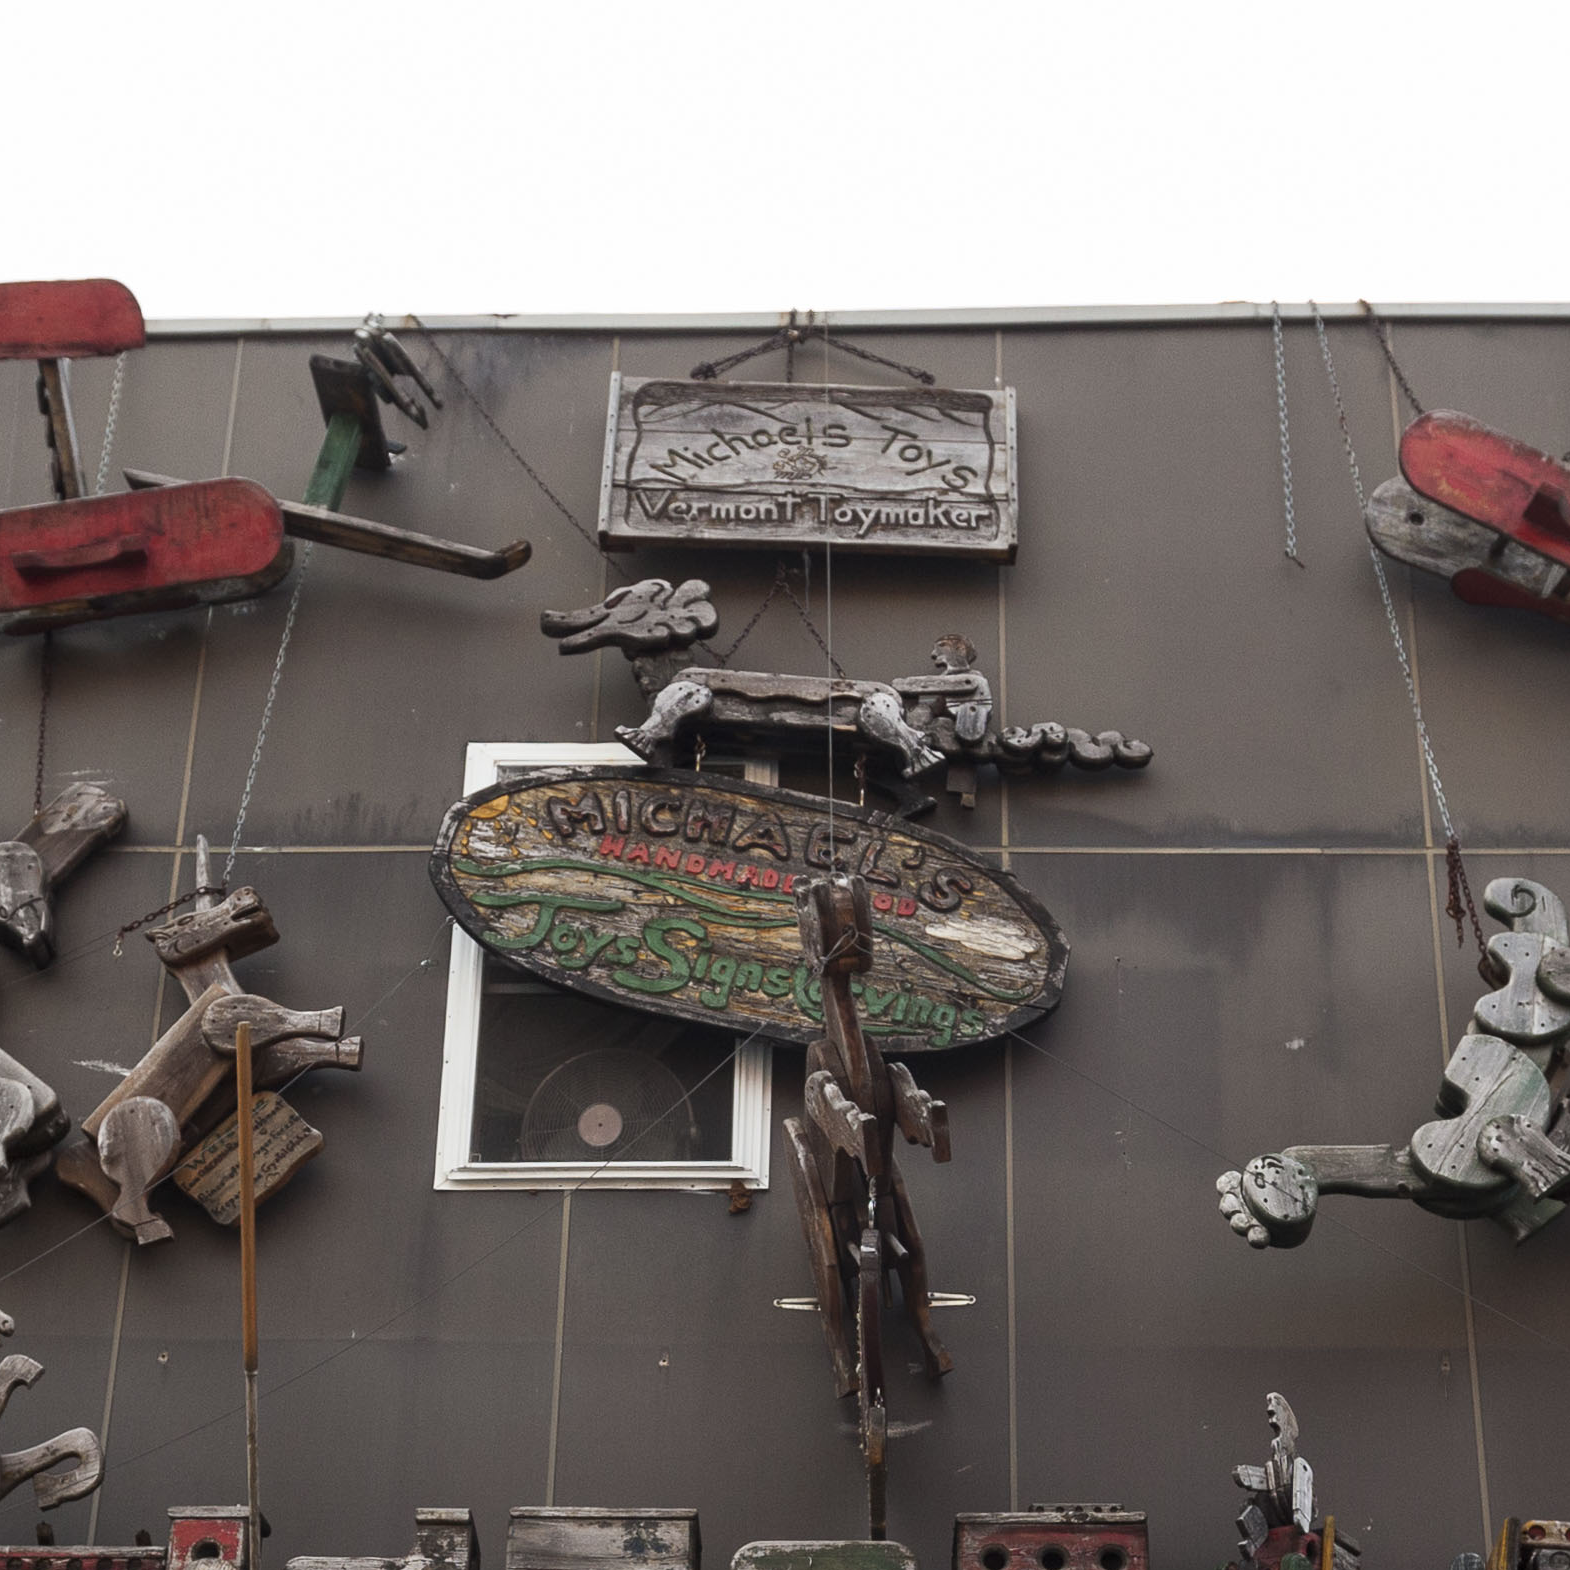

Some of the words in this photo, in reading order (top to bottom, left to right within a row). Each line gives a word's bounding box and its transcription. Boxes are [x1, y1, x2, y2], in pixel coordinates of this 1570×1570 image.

[649, 415, 853, 484] Michaels
[878, 423, 979, 491] Toys
[635, 488, 804, 523] Vermont
[805, 491, 993, 538] Toymaker
[545, 789, 975, 914] MICHAEL'S
[471, 893, 641, 969] Toys
[613, 917, 793, 1010] Signs
